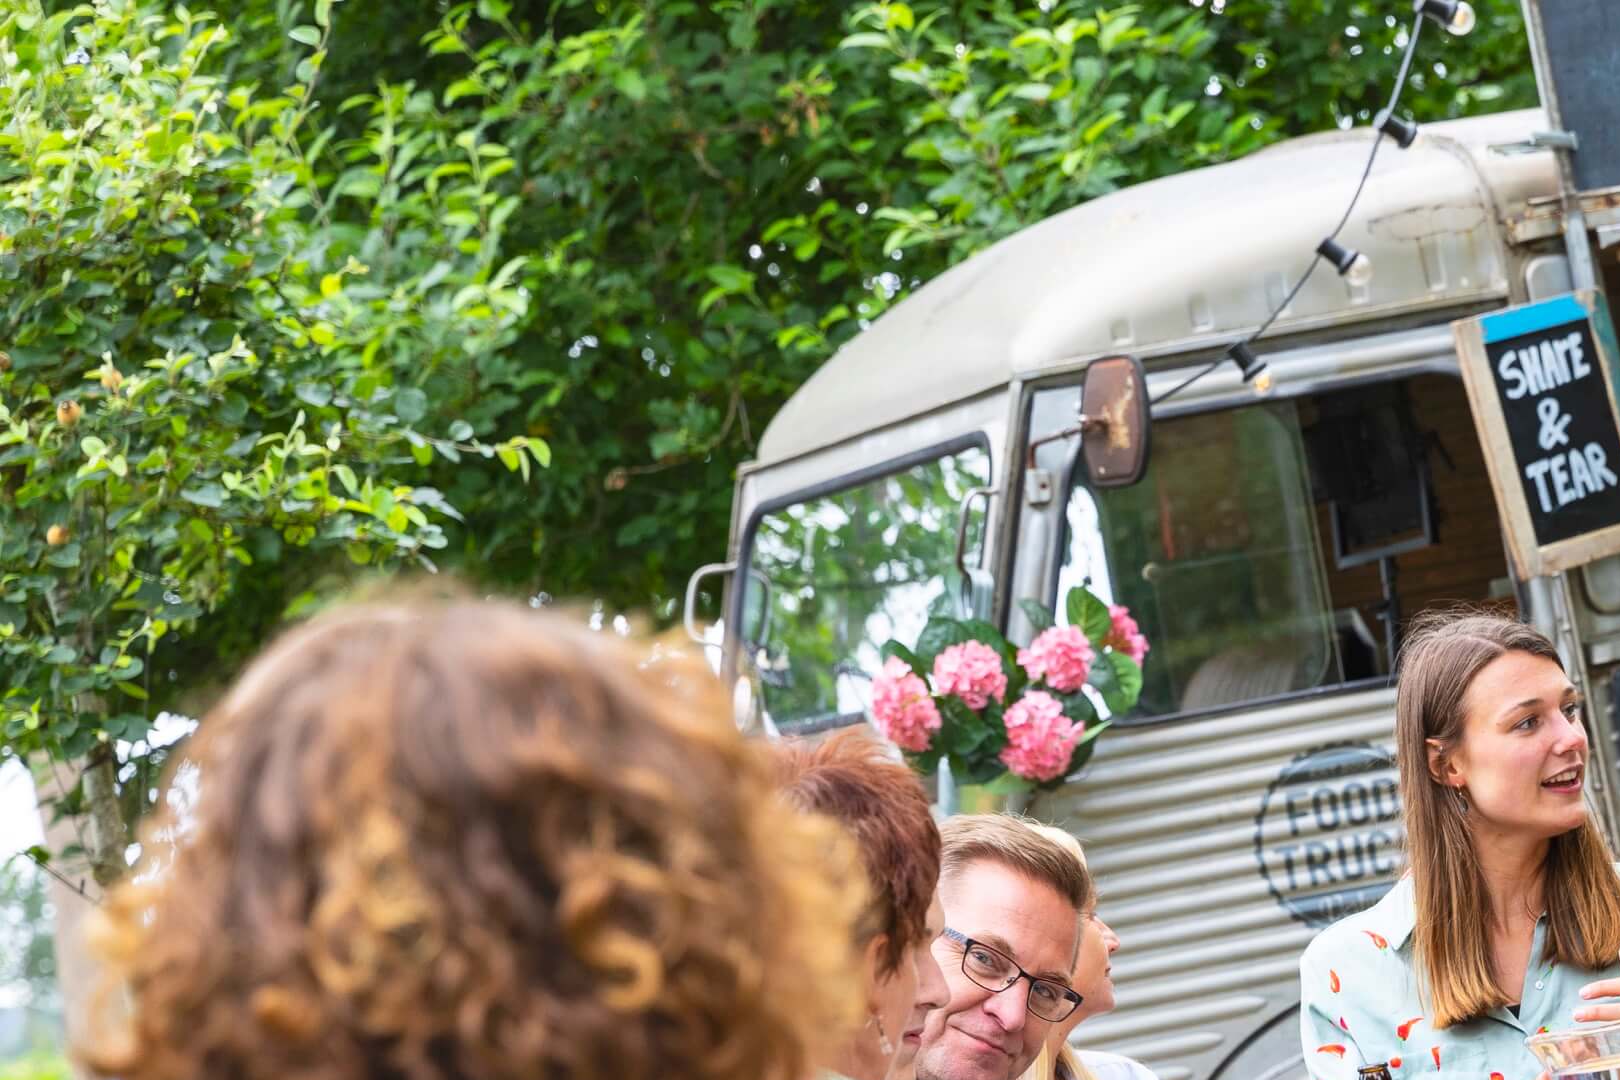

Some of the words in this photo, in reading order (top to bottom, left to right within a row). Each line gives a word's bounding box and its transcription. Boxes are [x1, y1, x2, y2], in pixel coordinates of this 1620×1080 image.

[1536, 397, 1572, 450] &
[1524, 441, 1618, 513] TEAR
[1274, 830, 1396, 890] TRUC
